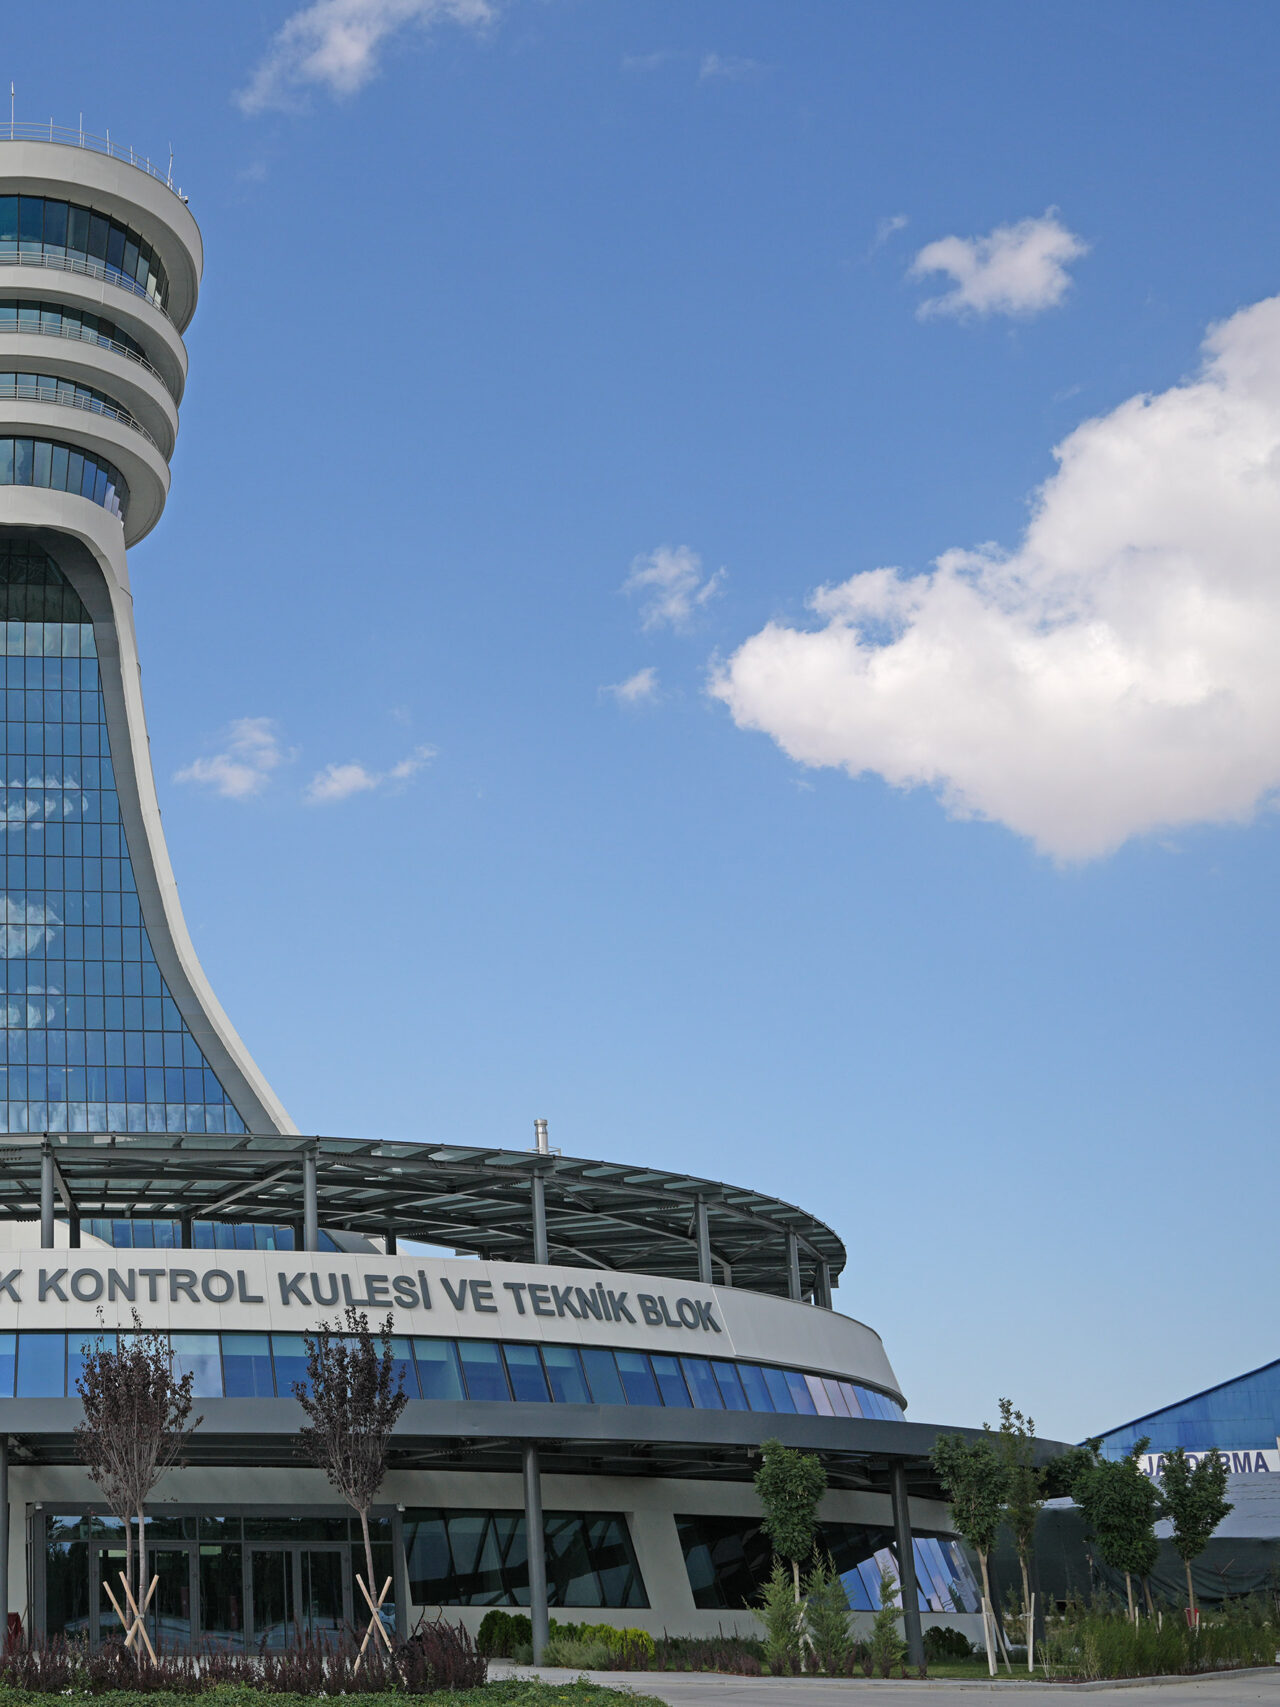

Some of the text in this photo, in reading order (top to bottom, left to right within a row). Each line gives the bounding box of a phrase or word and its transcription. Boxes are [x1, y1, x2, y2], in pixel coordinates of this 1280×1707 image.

[38, 1268, 264, 1303] KONTROL
[277, 1269, 432, 1309] KULESİ
[440, 1277, 498, 1313] VE
[503, 1281, 637, 1324] TEKNİK
[636, 1293, 722, 1333] BLOK
[1143, 1451, 1270, 1477] JADRMA
